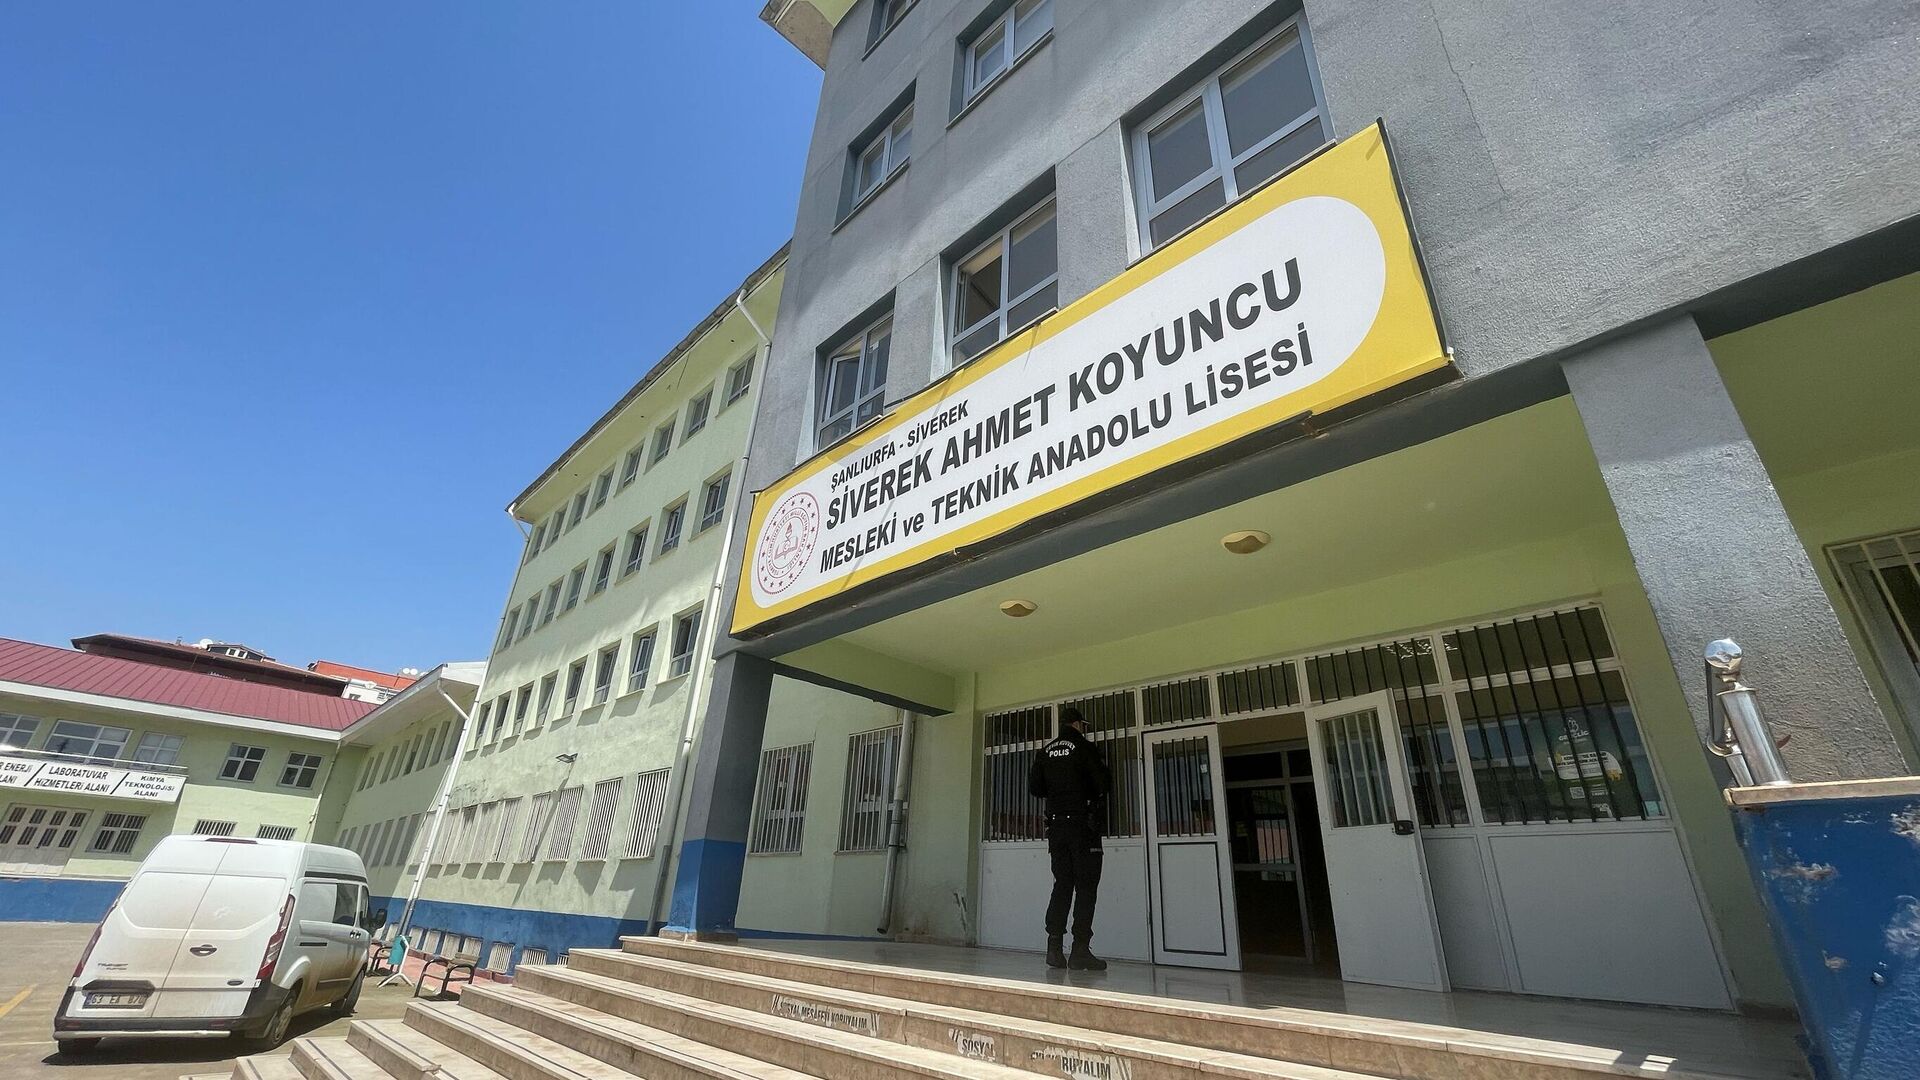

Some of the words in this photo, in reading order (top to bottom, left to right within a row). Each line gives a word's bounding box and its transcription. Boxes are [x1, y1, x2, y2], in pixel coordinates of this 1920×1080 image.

[826, 448, 934, 530] SİVEREK
[940, 384, 1056, 475] AHMET
[1069, 257, 1302, 412] KOYUNCU
[820, 512, 897, 573] MESLEKİ
[902, 512, 924, 538] ve
[931, 461, 1020, 525] TEKNİK
[1027, 392, 1172, 484] ANADOLU
[1184, 322, 1314, 415] LİSESİ
[831, 441, 895, 493] ŞANLIURFA
[907, 399, 968, 448] SİVEREK
[4, 762, 33, 773] ENERJİ
[49, 766, 109, 780] LABORATUVAR
[0, 774, 18, 784] LANI
[140, 775, 165, 783] KİMYA
[34, 778, 83, 791] HİZMETLERİ
[84, 783, 111, 793] ALANI
[124, 781, 175, 792] TEKNOLOJİSİ
[134, 790, 159, 798] ALANI
